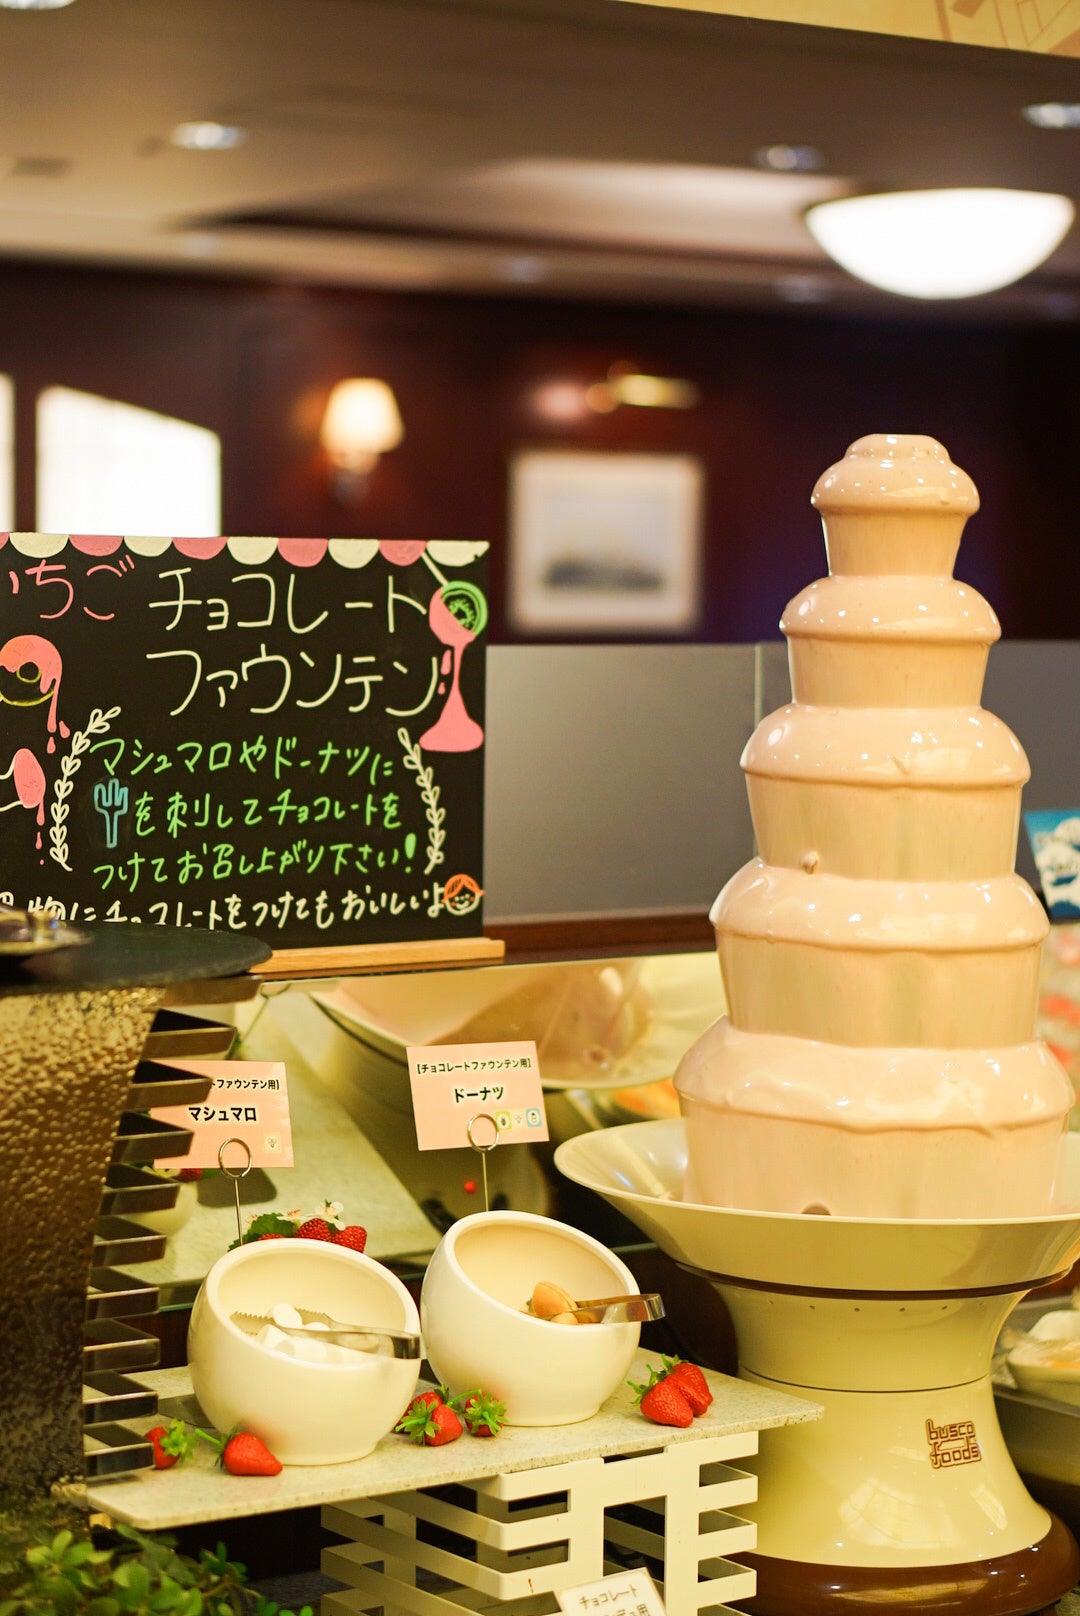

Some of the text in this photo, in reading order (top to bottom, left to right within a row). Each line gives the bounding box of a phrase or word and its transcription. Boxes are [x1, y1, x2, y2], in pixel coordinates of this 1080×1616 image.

[149, 567, 427, 634] チョコレート
[146, 643, 438, 716] ファウンテン
[89, 734, 394, 786] マシュマロやドーナツに
[134, 788, 402, 839] を刺してチョコレートを
[188, 1106, 257, 1122] マシュマロ
[454, 1086, 504, 1103] ドーナツ
[930, 1440, 980, 1467] foods
[579, 1584, 638, 1611] チョコレート
